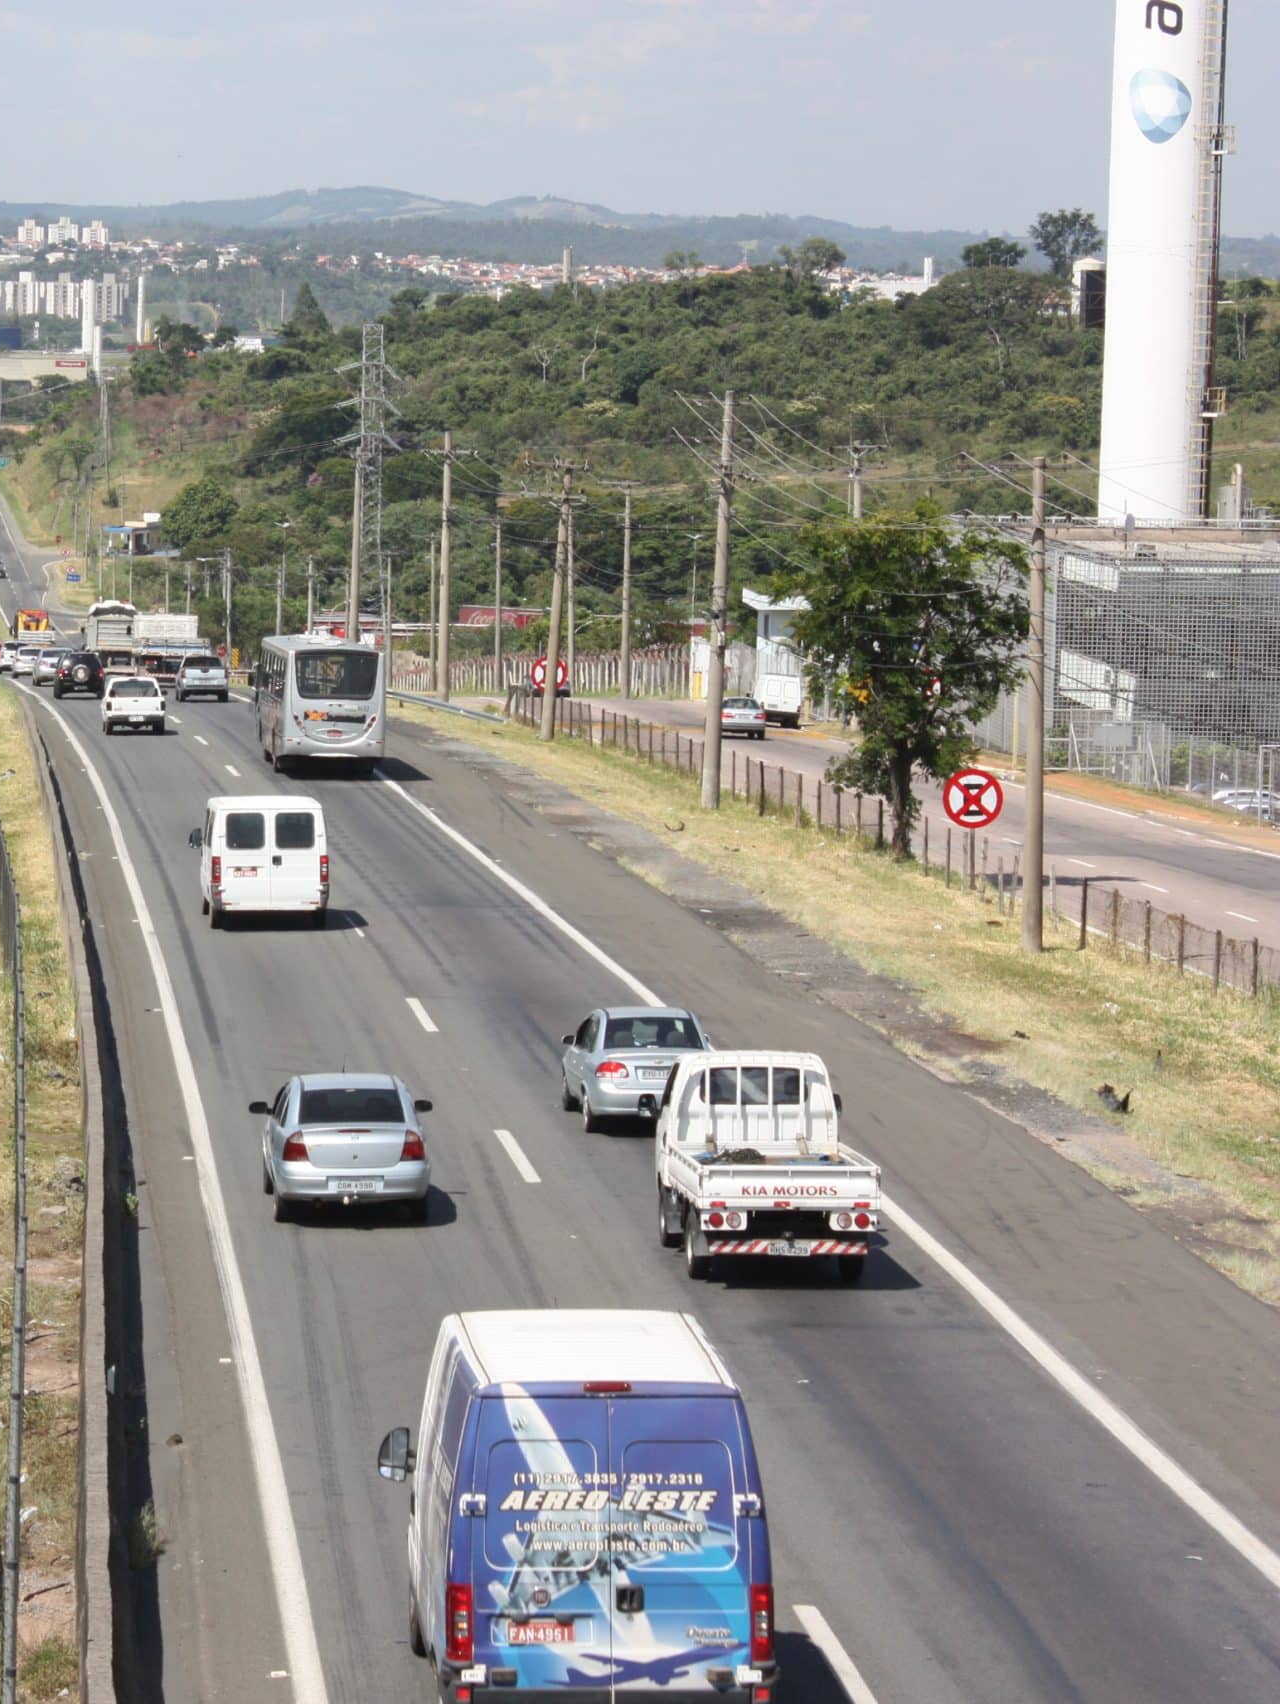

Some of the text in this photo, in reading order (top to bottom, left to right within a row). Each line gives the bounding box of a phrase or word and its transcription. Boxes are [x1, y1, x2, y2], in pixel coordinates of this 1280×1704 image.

[741, 1185, 838, 1196] KIA MOTORS
[500, 1490, 718, 1511] AEREO LESTE
[579, 1520, 640, 1533] Transporte
